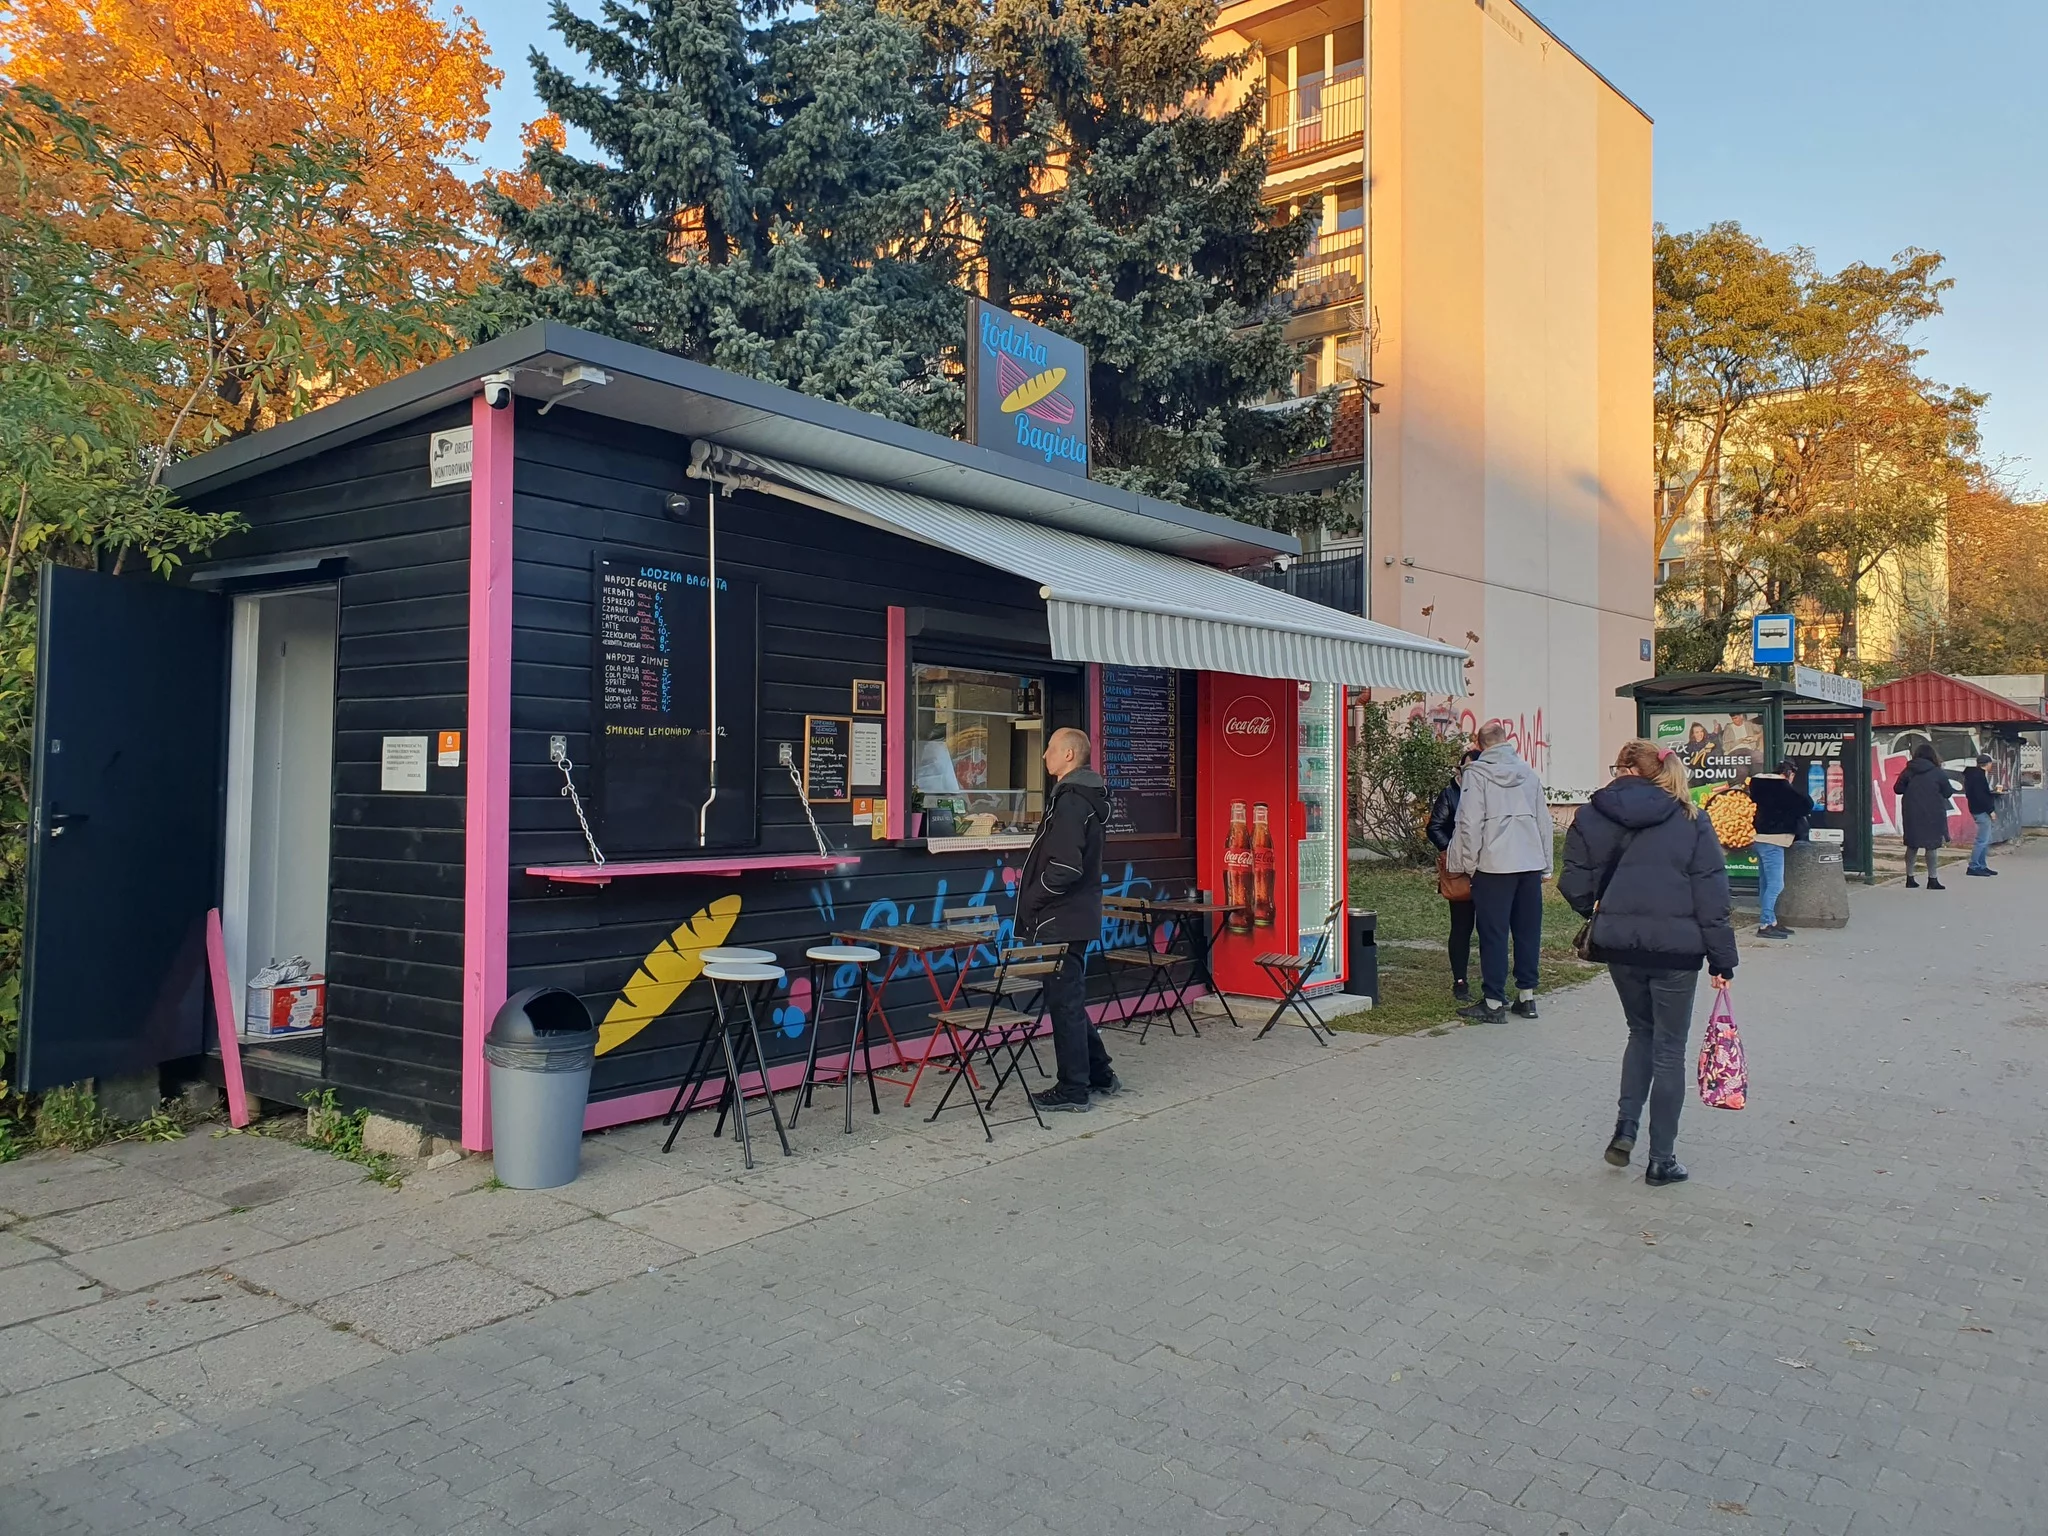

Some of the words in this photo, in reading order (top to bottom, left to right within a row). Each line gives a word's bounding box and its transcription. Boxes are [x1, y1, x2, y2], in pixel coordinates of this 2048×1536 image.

[1015, 412, 1088, 464] Bagieta
[455, 440, 472, 454] OBIEKT
[604, 575, 635, 587] NAPOJE
[637, 579, 668, 591] GORĄCE
[686, 574, 728, 592] BAGITA
[603, 586, 634, 598] HERBATA
[602, 596, 635, 606] ESPRESSO
[602, 604, 629, 614] CZARNA
[602, 614, 640, 624] CAPPUCCINO
[602, 622, 620, 630] LATTE
[602, 630, 637, 640] CZEKOLADA
[606, 653, 635, 664] NAPOJE
[604, 678, 627, 686] SPRITE
[605, 725, 645, 736] SMAKOWE
[1659, 724, 1684, 732] Knorr
[811, 736, 834, 746] KWOKA
[1667, 740, 1689, 754] Fix
[1784, 742, 1843, 756] MOVE
[1707, 756, 1752, 766] CHEESE
[1695, 769, 1737, 779] DOMU
